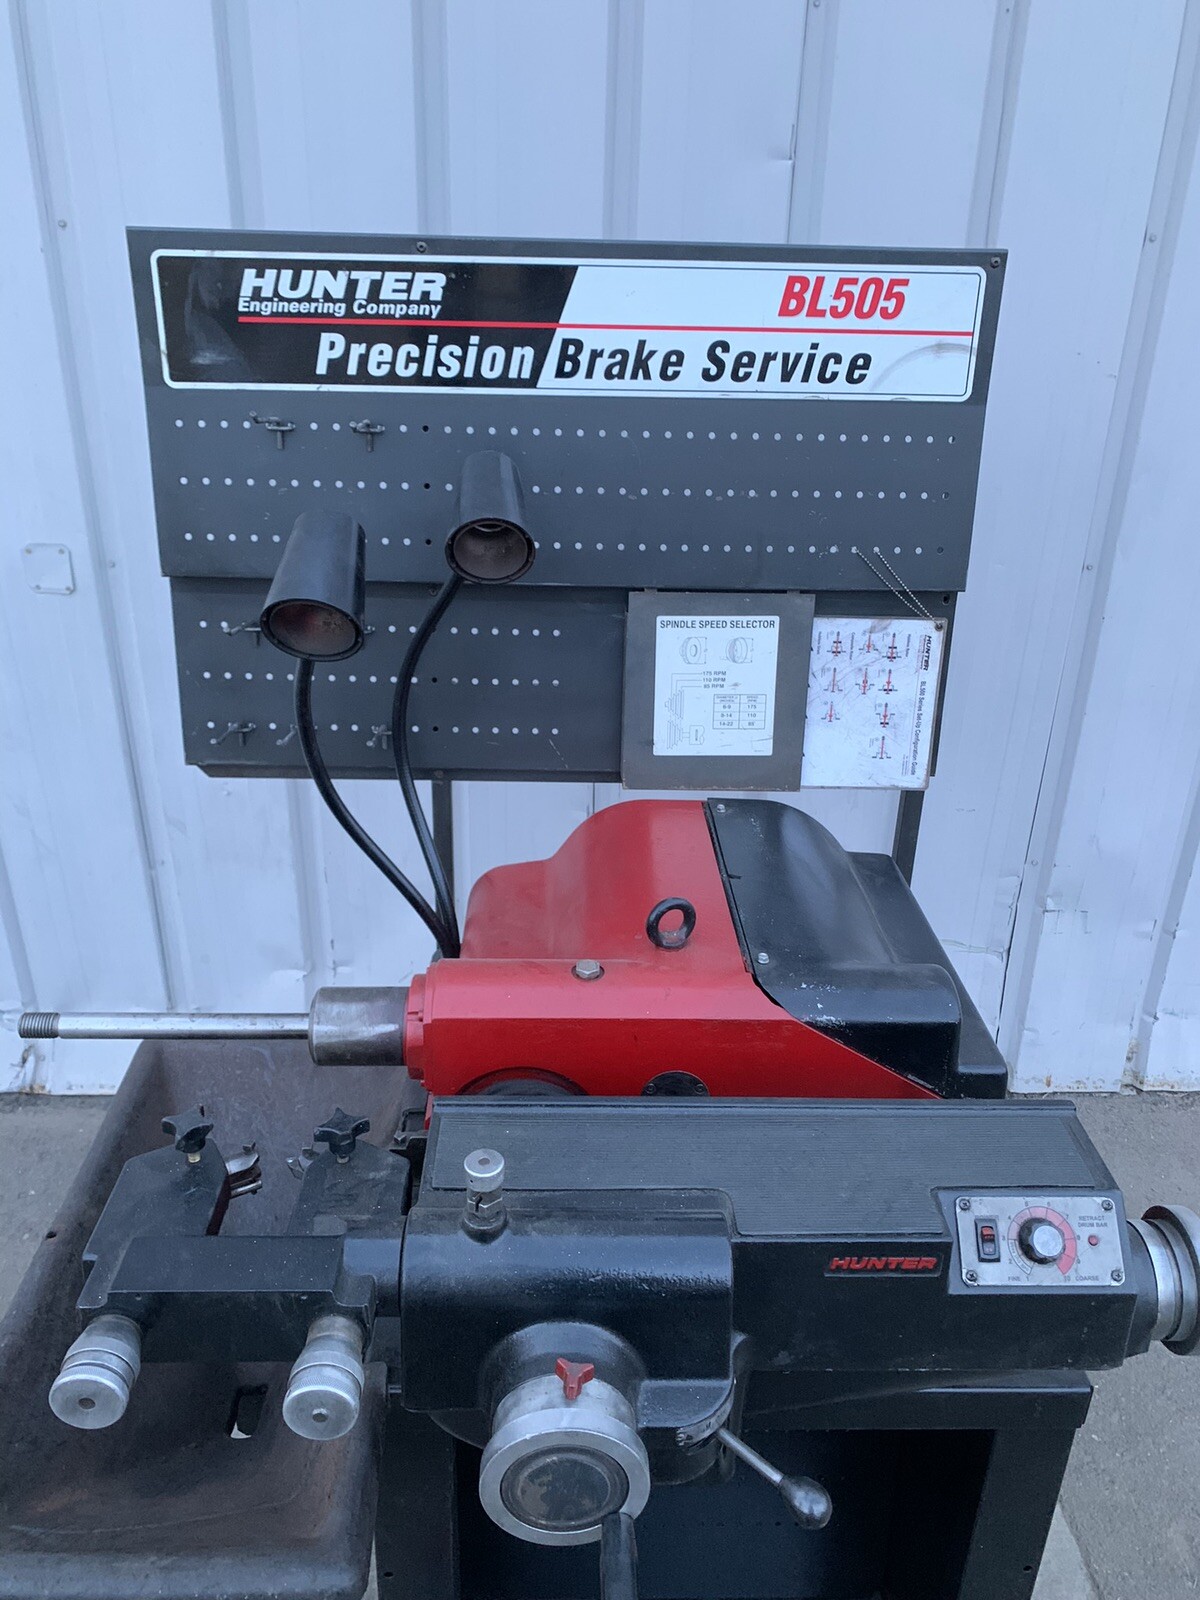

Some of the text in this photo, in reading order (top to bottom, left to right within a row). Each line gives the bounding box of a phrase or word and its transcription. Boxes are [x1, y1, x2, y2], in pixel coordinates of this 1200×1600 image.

[239, 268, 447, 301] HUNTER
[778, 275, 910, 320] BL505
[238, 298, 442, 318] Engineering Company
[315, 332, 873, 385] Precision Brake Service
[660, 620, 776, 629] SPINDLE SPEED SELECTOR
[923, 635, 932, 671] HUNTER
[917, 697, 925, 712] Series
[915, 712, 923, 729] Set-Up
[912, 729, 921, 761] Configuration
[830, 1256, 938, 1270] HUNTER
